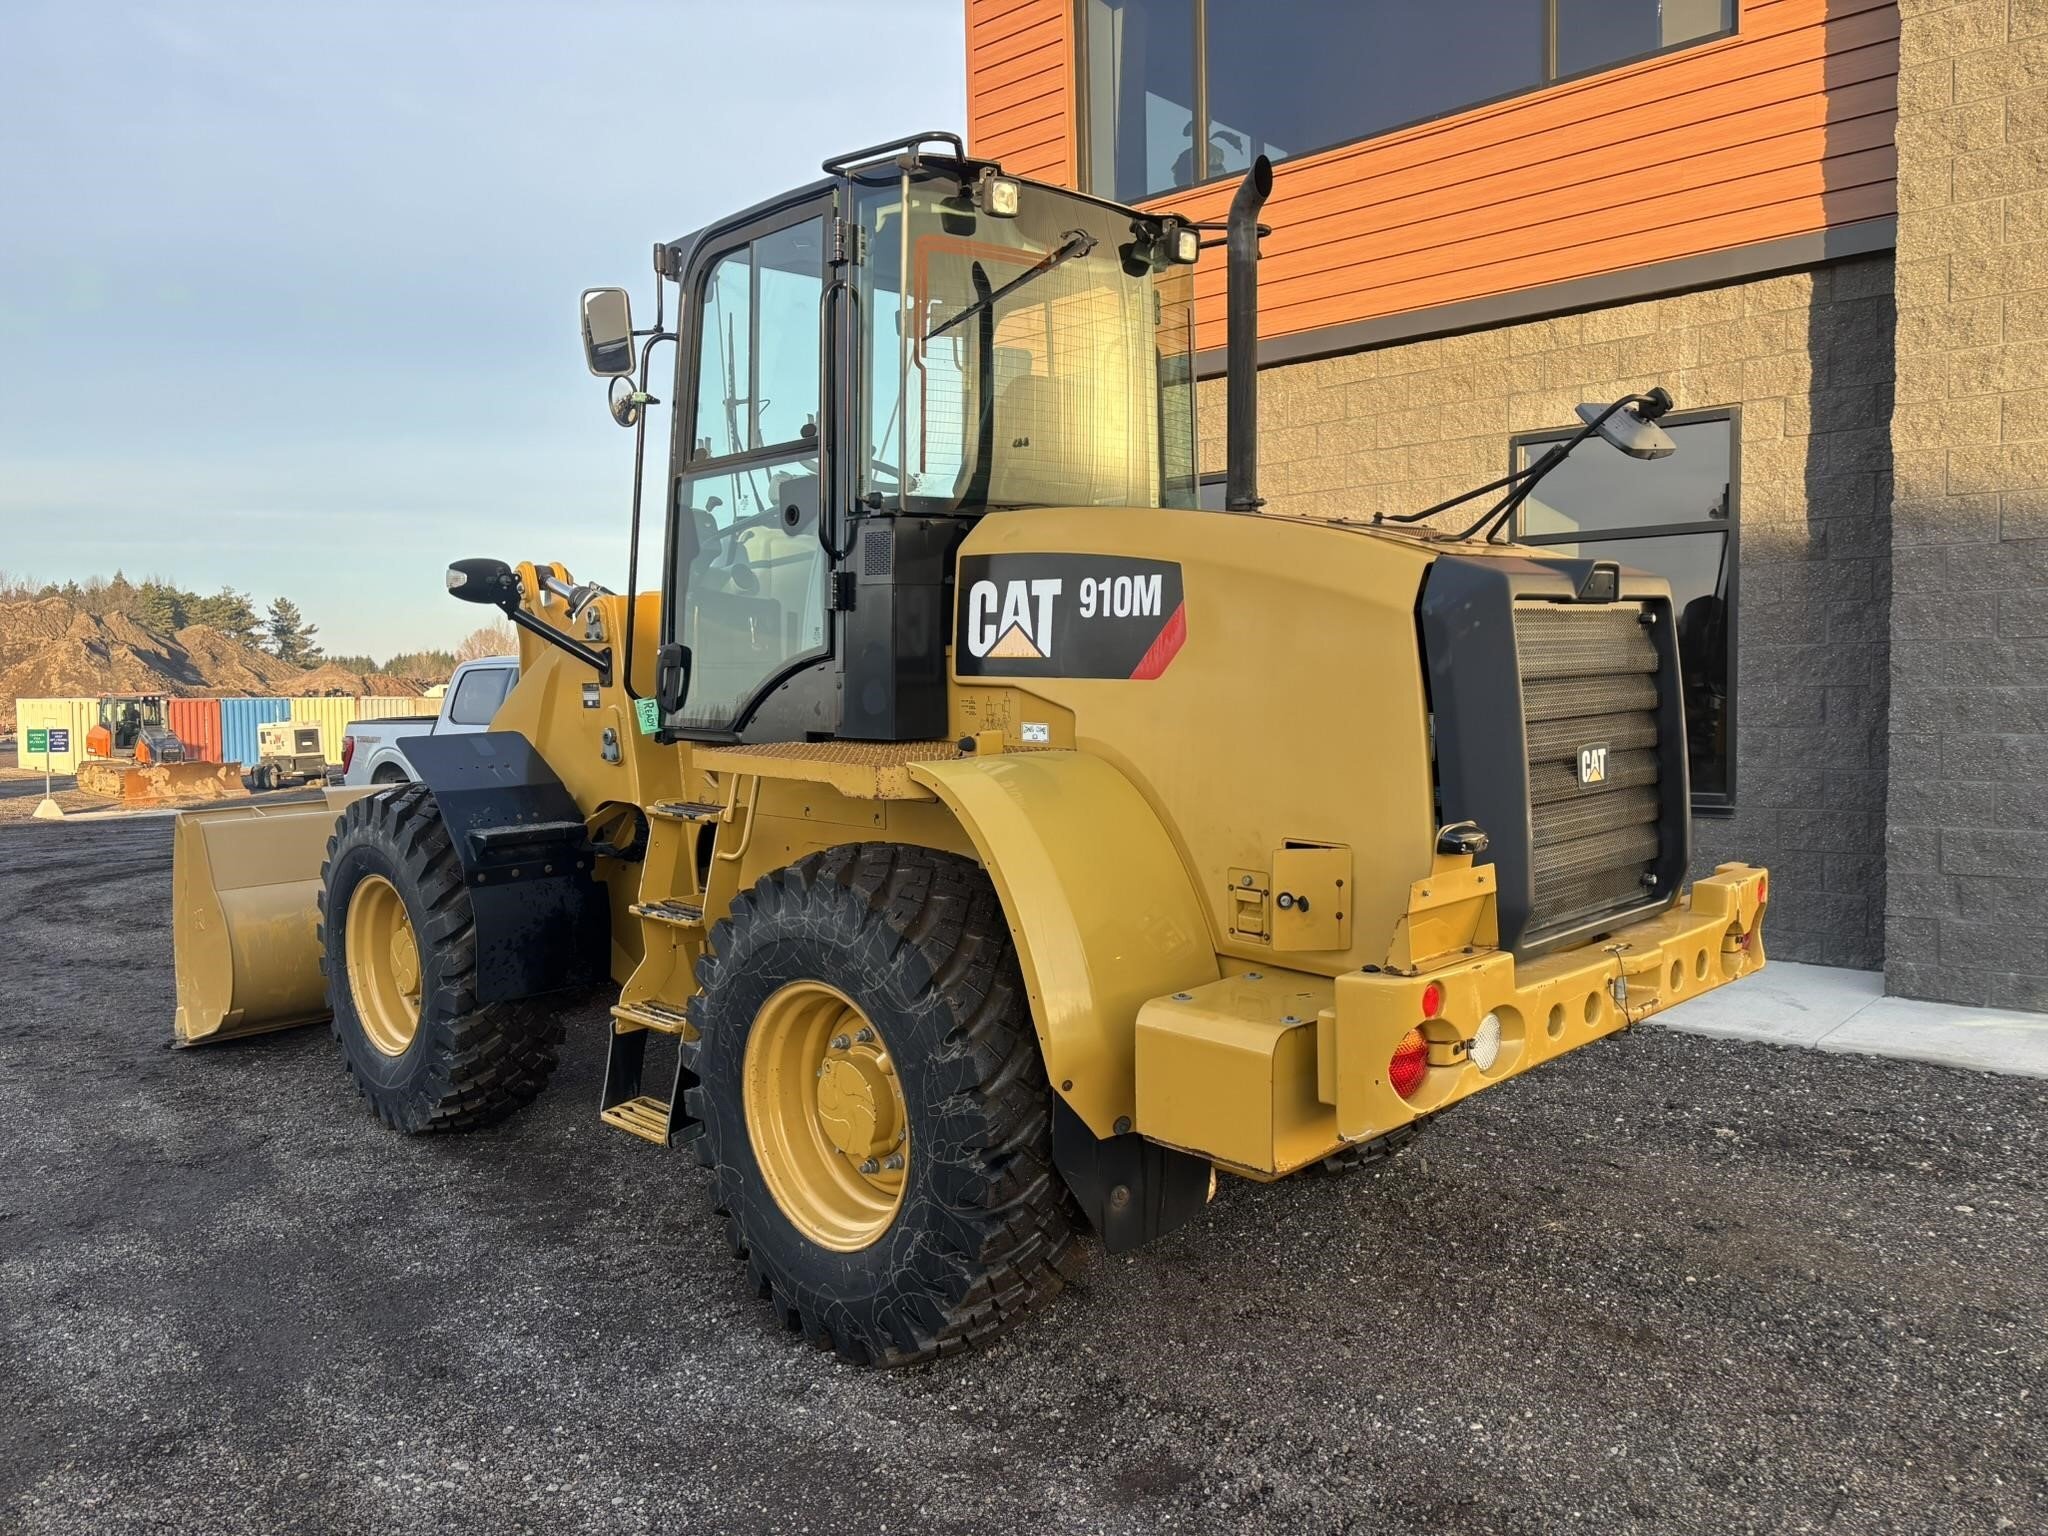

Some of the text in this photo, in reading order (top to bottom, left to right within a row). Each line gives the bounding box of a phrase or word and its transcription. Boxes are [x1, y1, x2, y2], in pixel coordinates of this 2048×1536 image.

[968, 574, 1163, 658] CAT 910M
[1581, 748, 1606, 783] CAT
